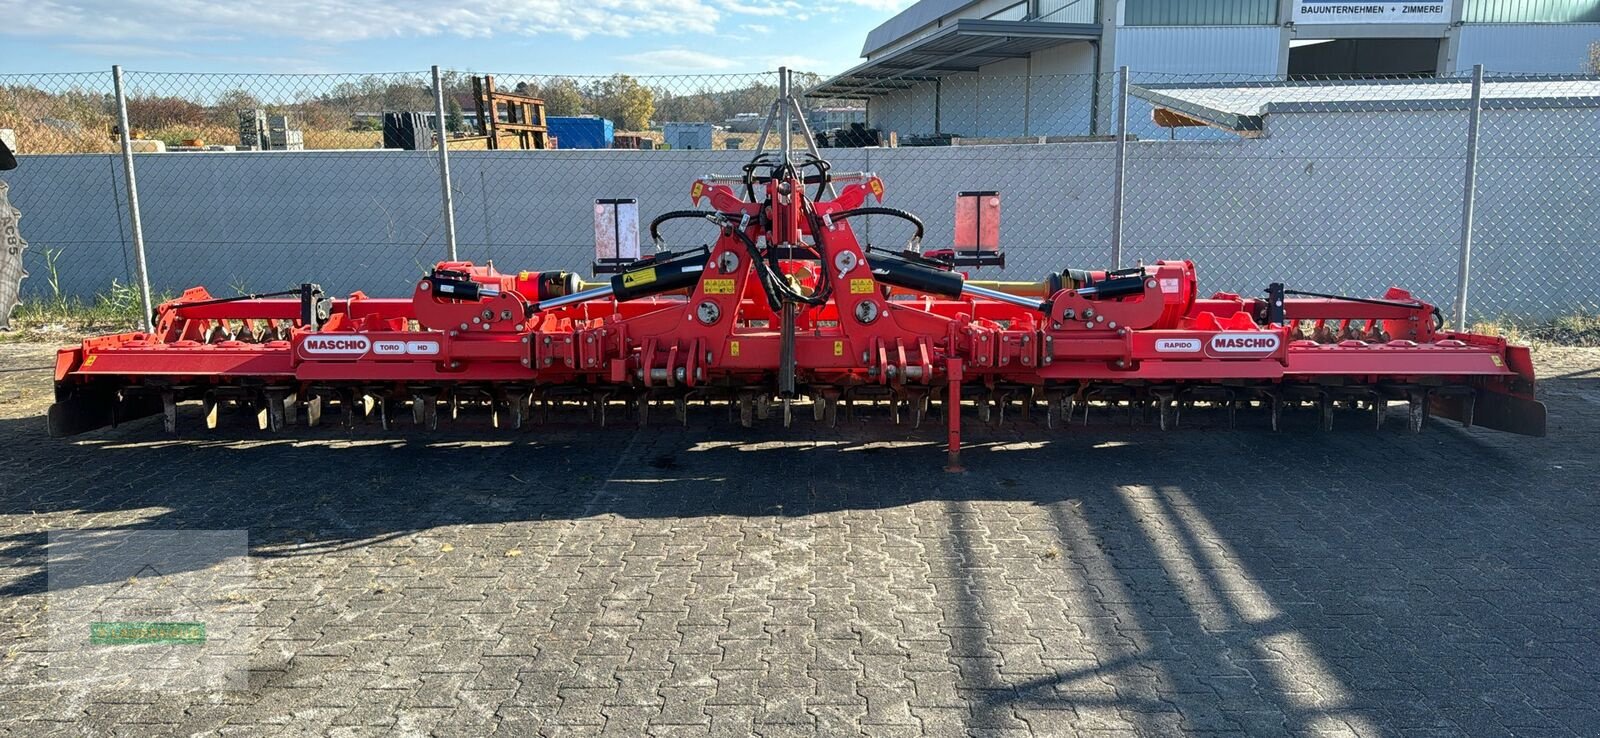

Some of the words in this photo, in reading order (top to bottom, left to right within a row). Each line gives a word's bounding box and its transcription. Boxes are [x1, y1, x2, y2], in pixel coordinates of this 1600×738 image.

[1301, 6, 1384, 14] BAUUNTERNEHMEN
[1402, 5, 1443, 13] ZIMMEREI
[307, 340, 366, 349] MASCHIO
[1215, 338, 1276, 348] MASCHIO
